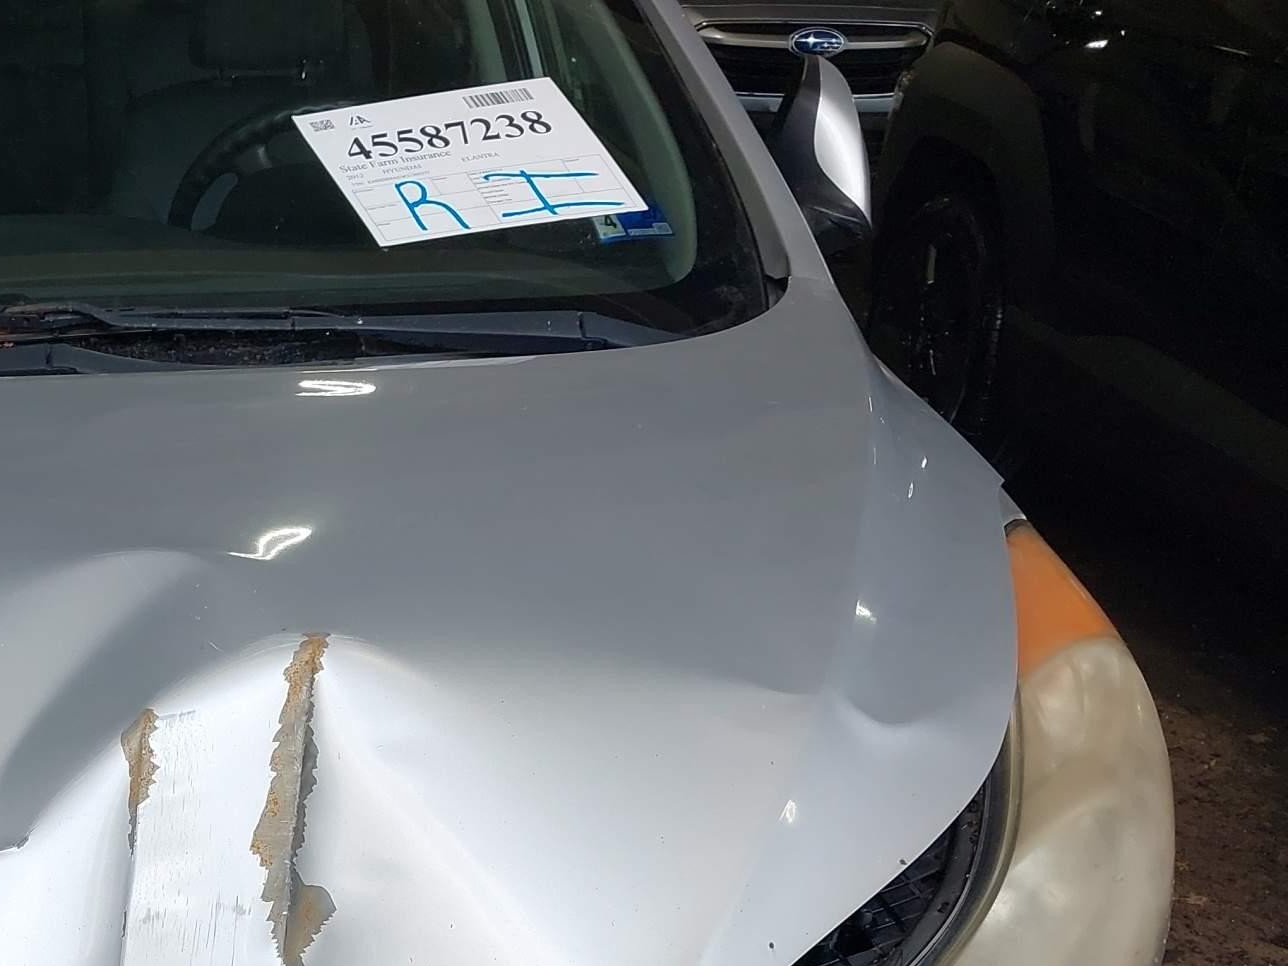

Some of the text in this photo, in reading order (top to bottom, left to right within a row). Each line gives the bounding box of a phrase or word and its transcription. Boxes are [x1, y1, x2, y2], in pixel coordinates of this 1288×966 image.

[347, 110, 553, 160] 45587238
[339, 150, 452, 174] State Farm Insurance
[461, 151, 500, 162] ELANTRA
[394, 180, 472, 231] R
